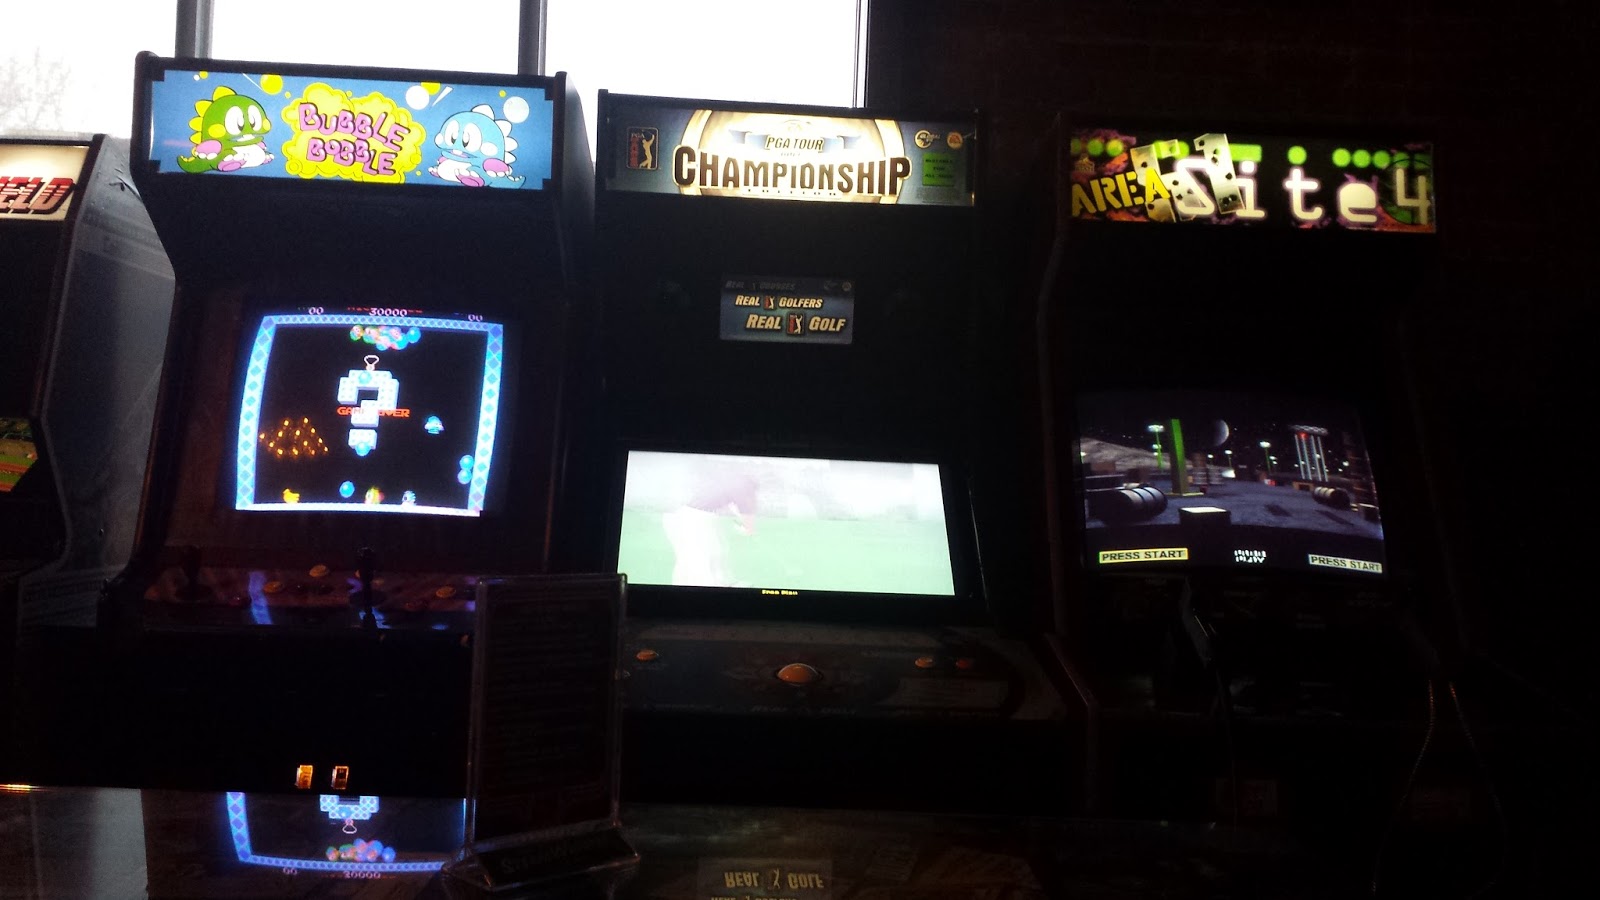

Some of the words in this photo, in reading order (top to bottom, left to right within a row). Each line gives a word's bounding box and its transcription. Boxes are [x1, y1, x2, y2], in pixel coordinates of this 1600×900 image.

[299, 102, 411, 152] BUBBLE
[766, 137, 791, 149] PGA
[793, 138, 824, 151] TOUR
[306, 137, 397, 176] BOBBLE
[674, 145, 911, 196] CHAMPIONSHIP
[0, 176, 75, 213] ELD
[1071, 168, 1170, 217] AREA
[735, 295, 761, 306] REAL
[778, 297, 824, 309] GOLFERS
[369, 307, 408, 317] 30000
[746, 314, 782, 330] REAL
[809, 316, 846, 332] GOLF
[1102, 551, 1140, 561] PRESS
[1144, 550, 1184, 559] START
[1310, 556, 1347, 567] PRESS
[1350, 561, 1380, 571] START
